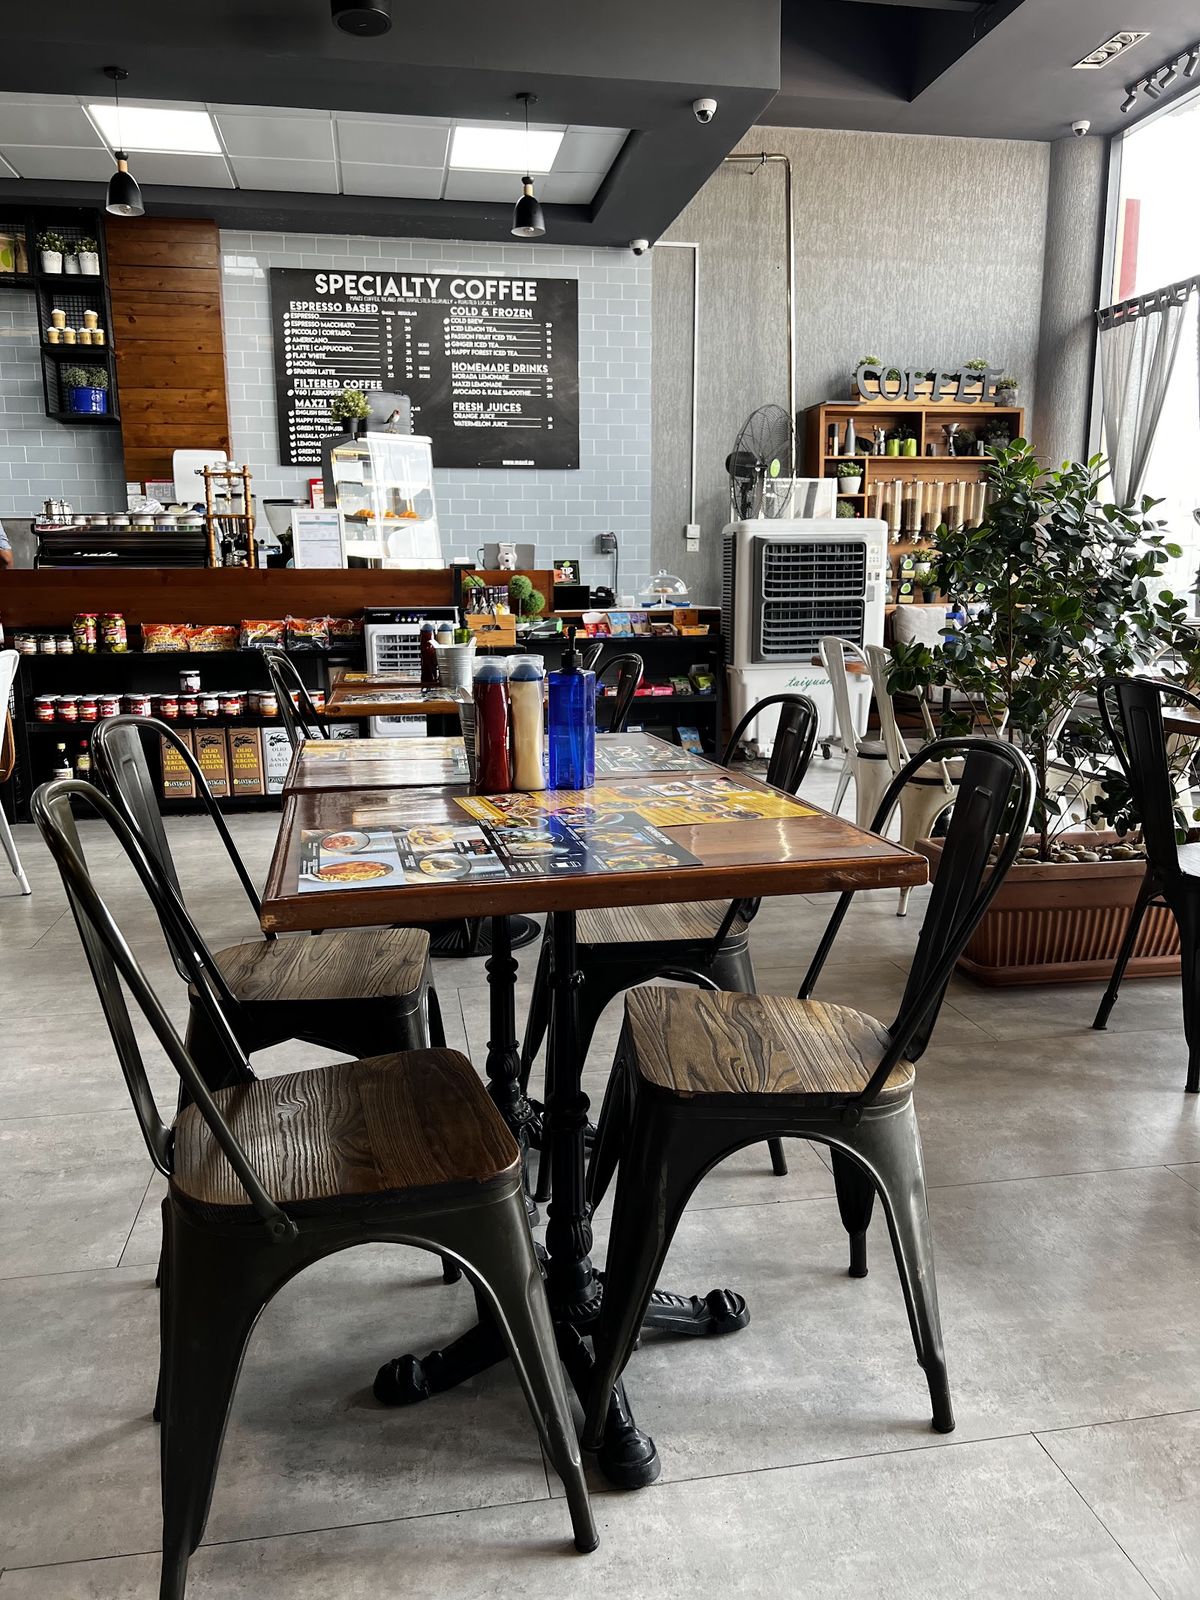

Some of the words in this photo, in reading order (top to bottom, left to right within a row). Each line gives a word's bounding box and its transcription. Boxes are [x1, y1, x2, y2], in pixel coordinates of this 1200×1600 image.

[315, 273, 441, 298] SPECIALTY
[449, 278, 538, 302] COFFEE
[290, 301, 342, 312] ESPRESSO
[346, 303, 378, 313] BASED
[450, 306, 478, 316] COLD
[482, 308, 490, 316] &
[492, 308, 532, 318] FROZEN
[452, 362, 510, 372] HOMEMADE
[513, 364, 548, 373] DRINKS
[294, 379, 340, 388] FILTERED
[343, 380, 383, 389] COFFEE
[857, 364, 1005, 404] COFFEE
[295, 399, 326, 408] MAXZI
[452, 402, 484, 411] FRESH
[487, 403, 522, 412] JUICES
